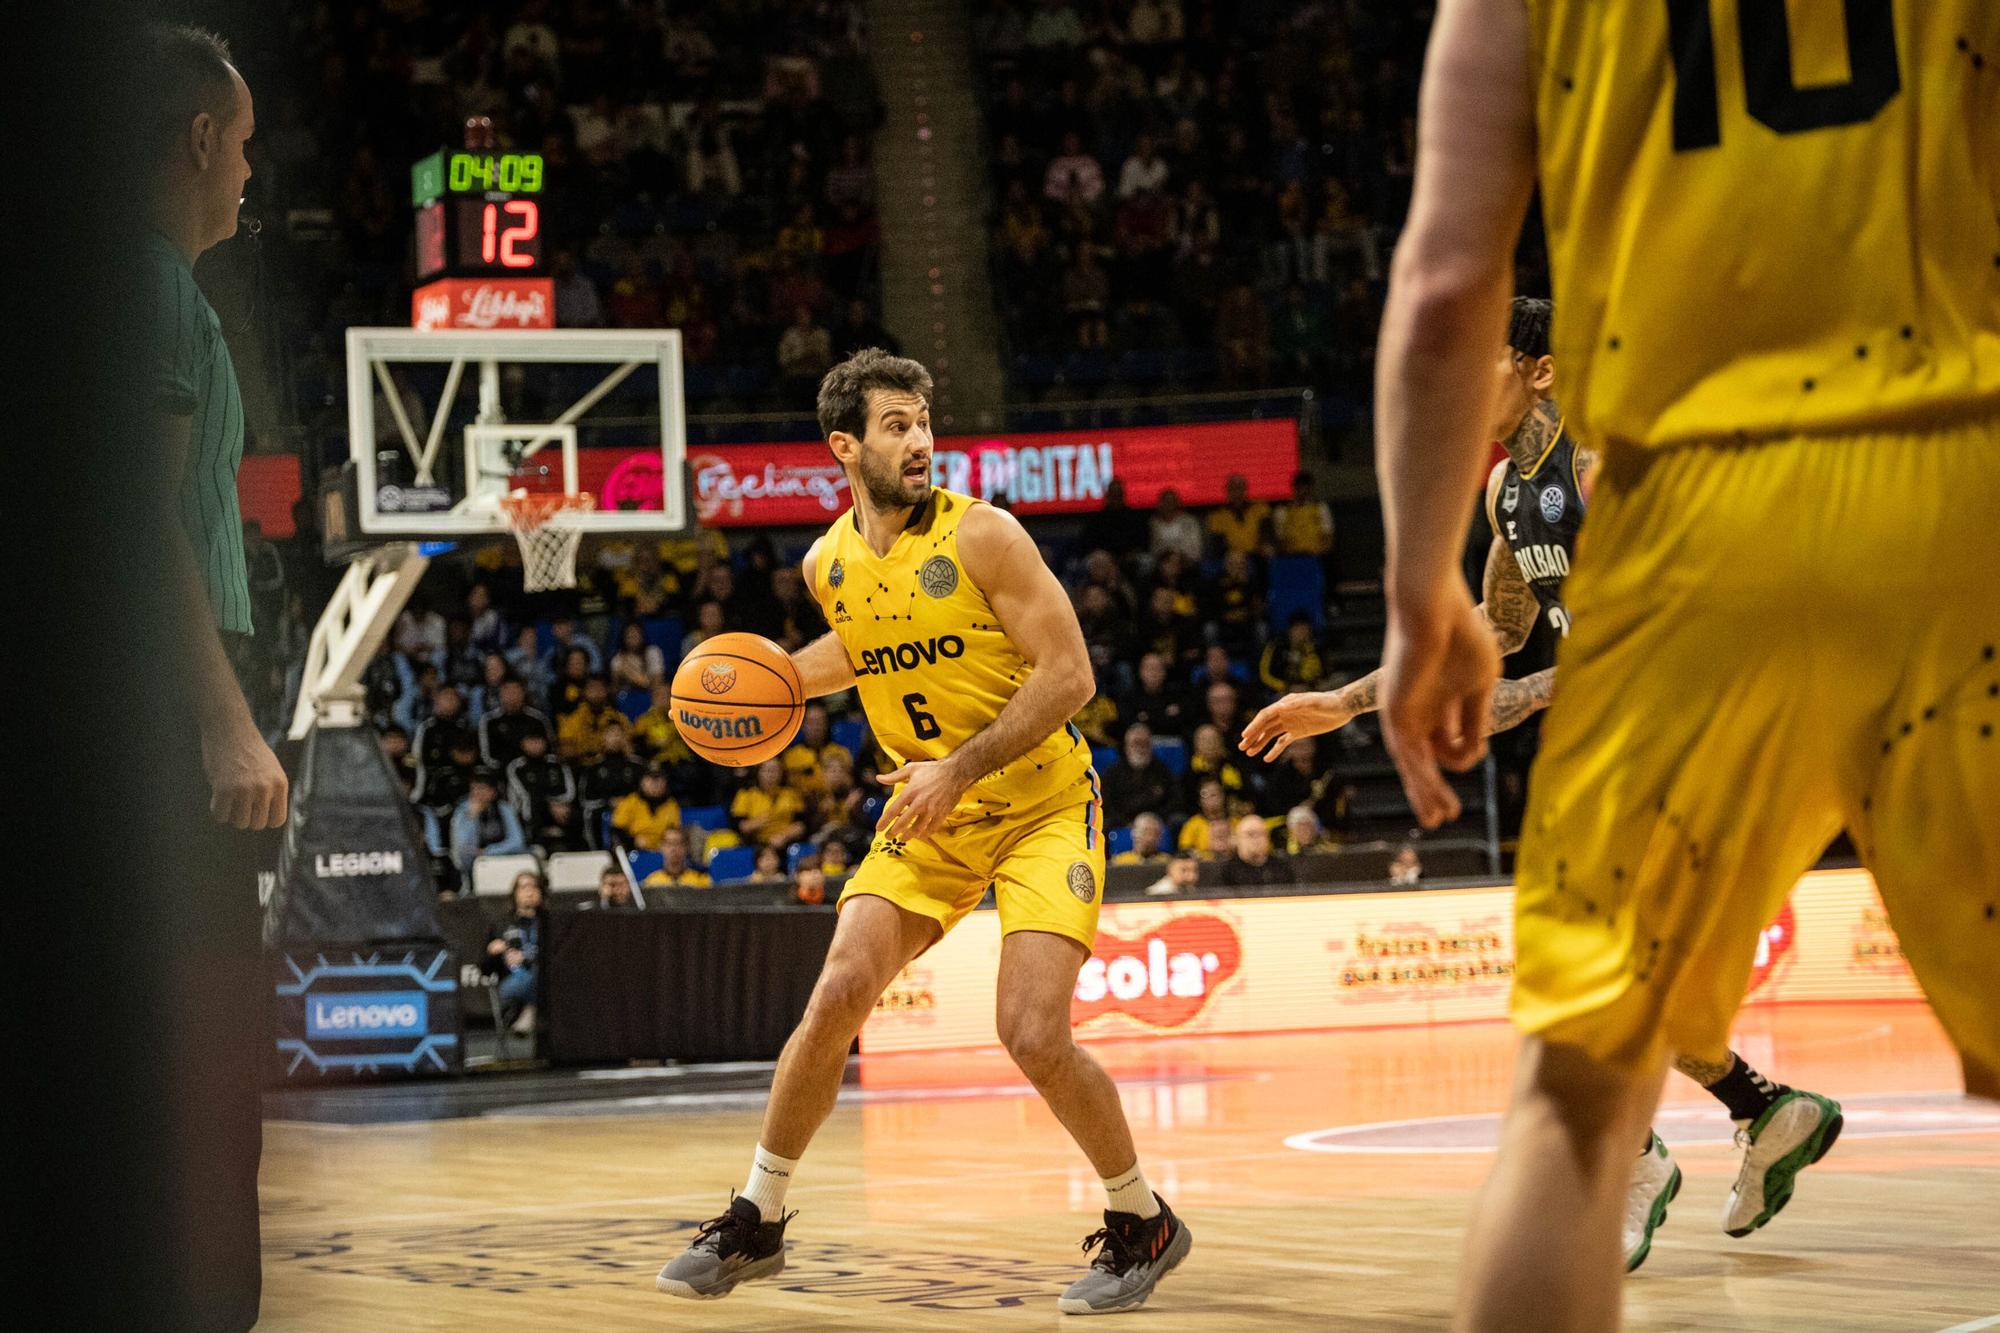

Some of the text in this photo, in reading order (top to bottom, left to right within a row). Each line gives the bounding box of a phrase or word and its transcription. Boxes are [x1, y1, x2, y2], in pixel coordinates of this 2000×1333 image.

[1668, 0, 1902, 152] 10
[482, 201, 539, 268] 12
[1514, 544, 1570, 583] BILBAO
[680, 708, 763, 739] Wilson
[902, 692, 942, 741] 6
[315, 851, 403, 878] LEGION
[316, 1003, 417, 1029] Lenovo
